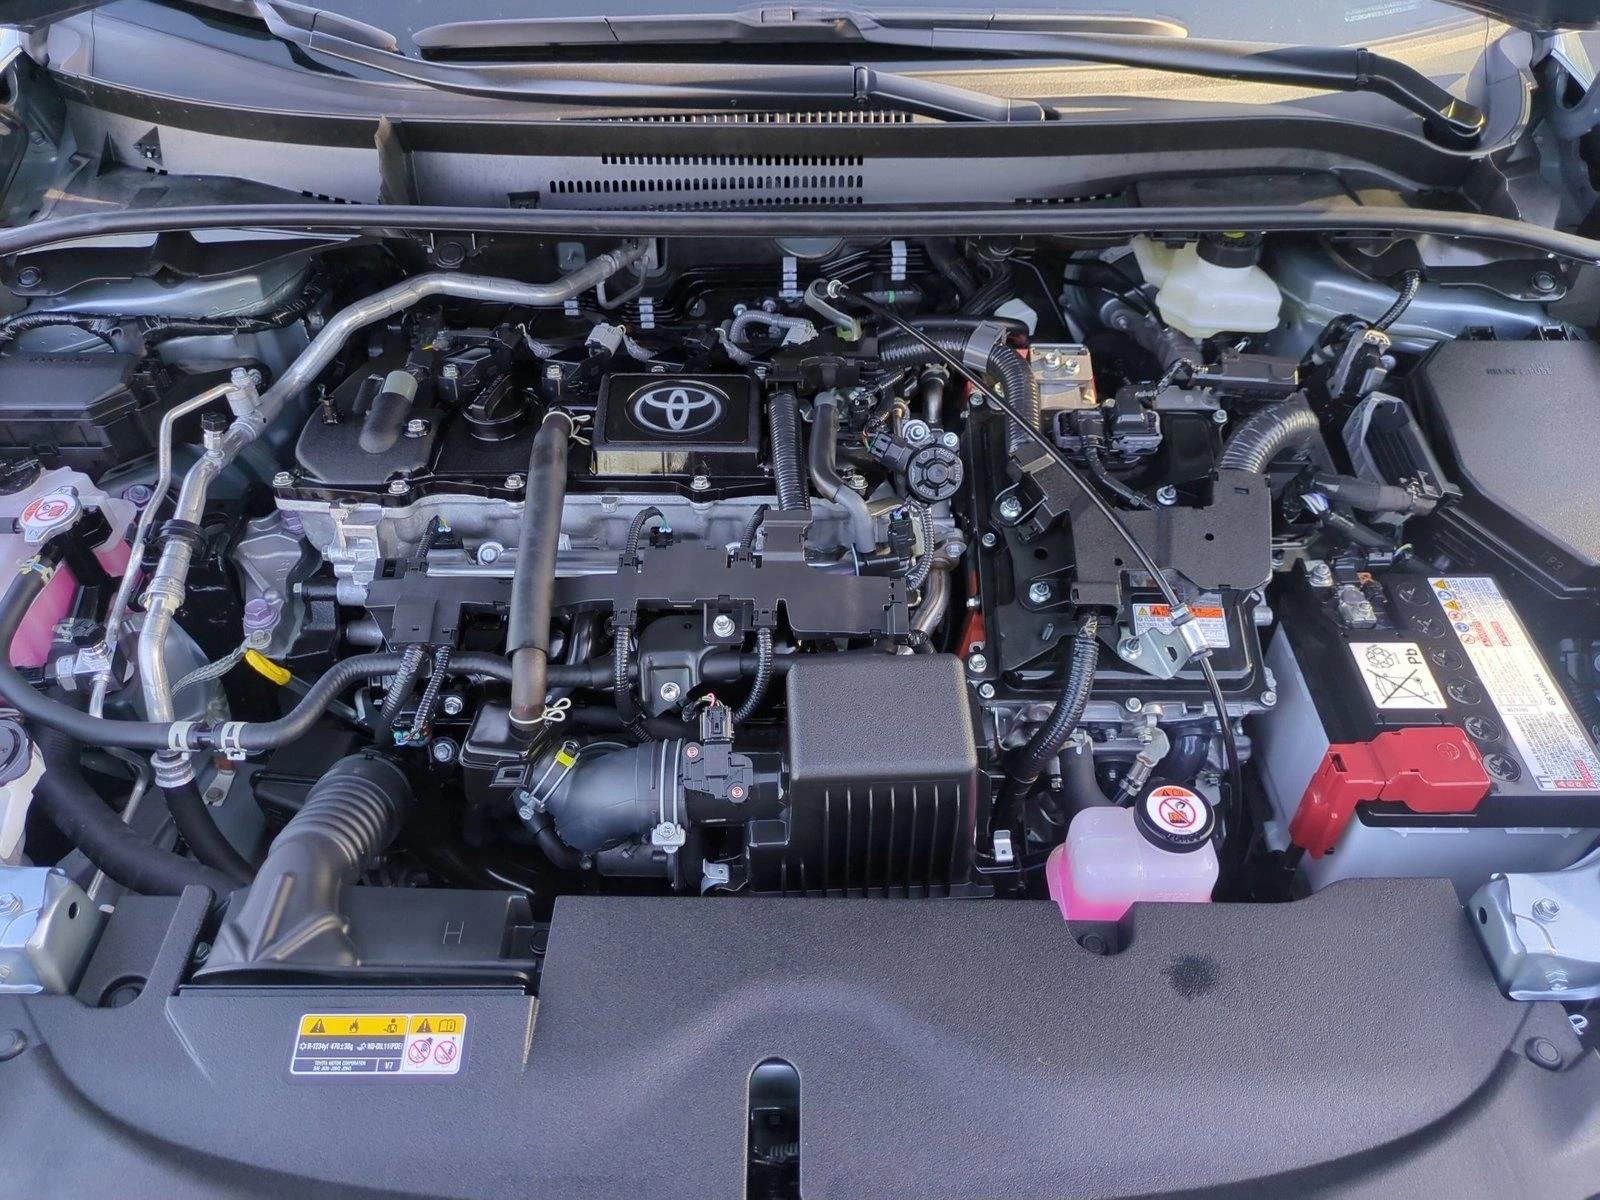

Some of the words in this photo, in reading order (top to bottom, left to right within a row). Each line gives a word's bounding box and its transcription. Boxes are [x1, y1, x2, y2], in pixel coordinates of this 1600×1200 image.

[1405, 648, 1422, 665] Pb
[1532, 673, 1551, 695] YUASA
[307, 1042, 329, 1051] R-1234yf
[385, 1061, 393, 1070] V7
